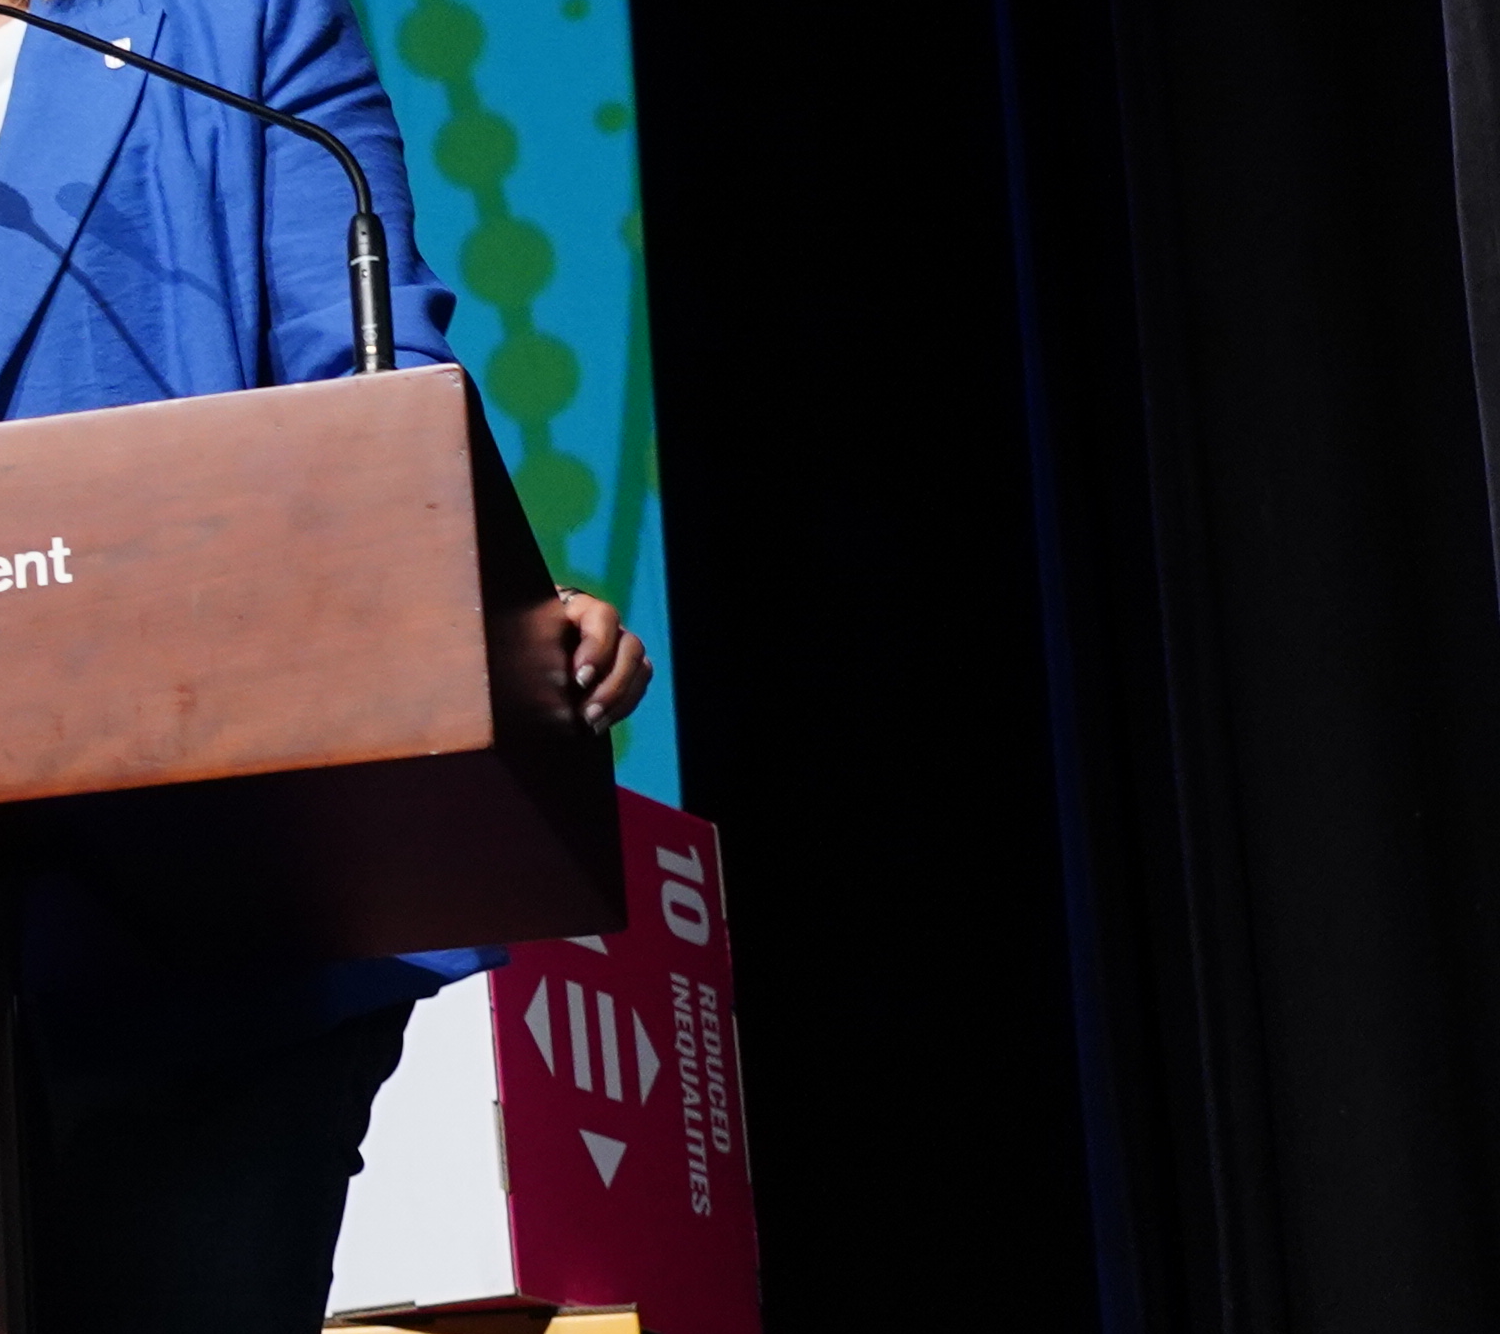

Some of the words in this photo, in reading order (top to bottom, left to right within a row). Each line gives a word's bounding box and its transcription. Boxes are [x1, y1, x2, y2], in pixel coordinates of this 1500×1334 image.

[655, 845, 710, 946] 10
[669, 972, 711, 1216] INEQUALITIES
[698, 983, 731, 1153] REDUCED
